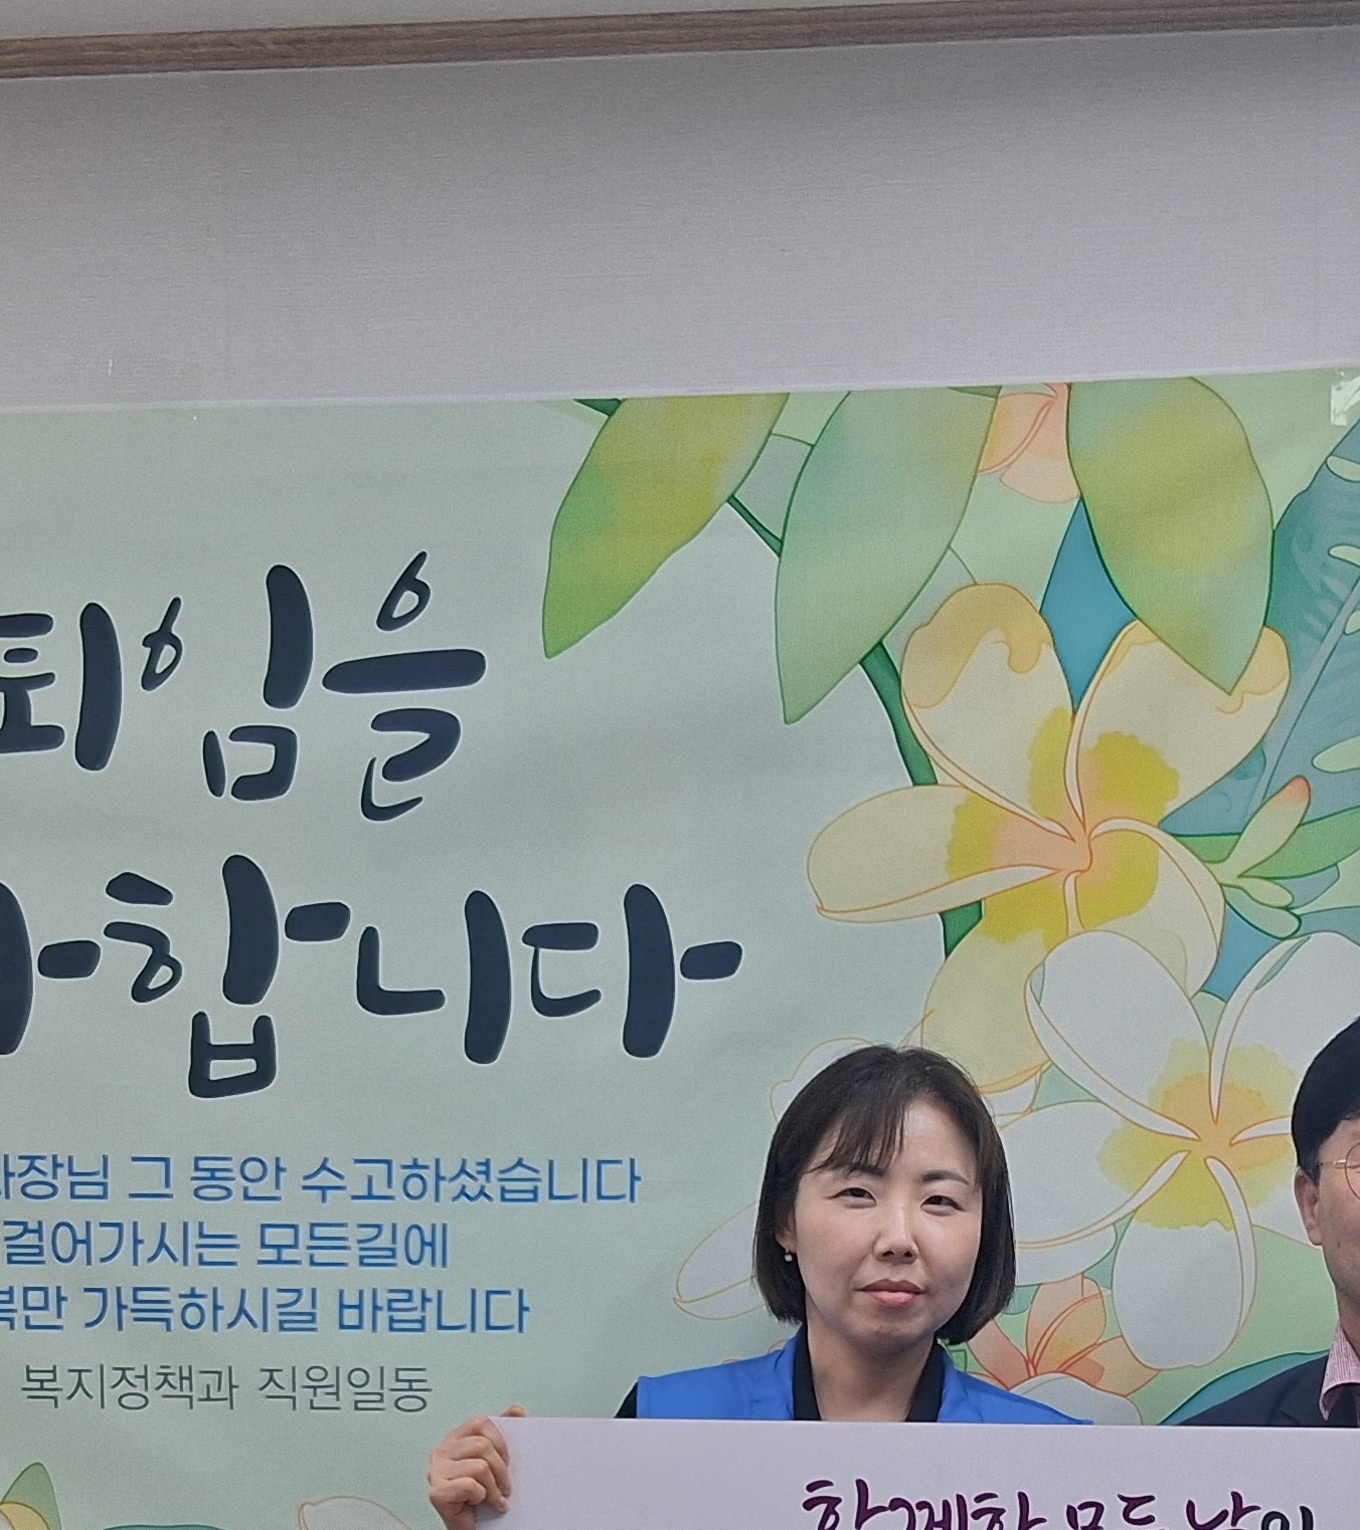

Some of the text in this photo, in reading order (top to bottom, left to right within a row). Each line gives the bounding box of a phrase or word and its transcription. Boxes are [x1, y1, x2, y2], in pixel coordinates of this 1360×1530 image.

[129, 1156, 173, 1198] 그
[191, 1157, 286, 1201] 동안
[302, 1158, 641, 1203] 수고하셨습니다
[3, 1221, 447, 1268] 걸어가시는 모든길에
[83, 1286, 317, 1332] 가득하시길
[339, 1288, 530, 1333] 바랍니다
[21, 1364, 432, 1412] 복지정책과 직원일동
